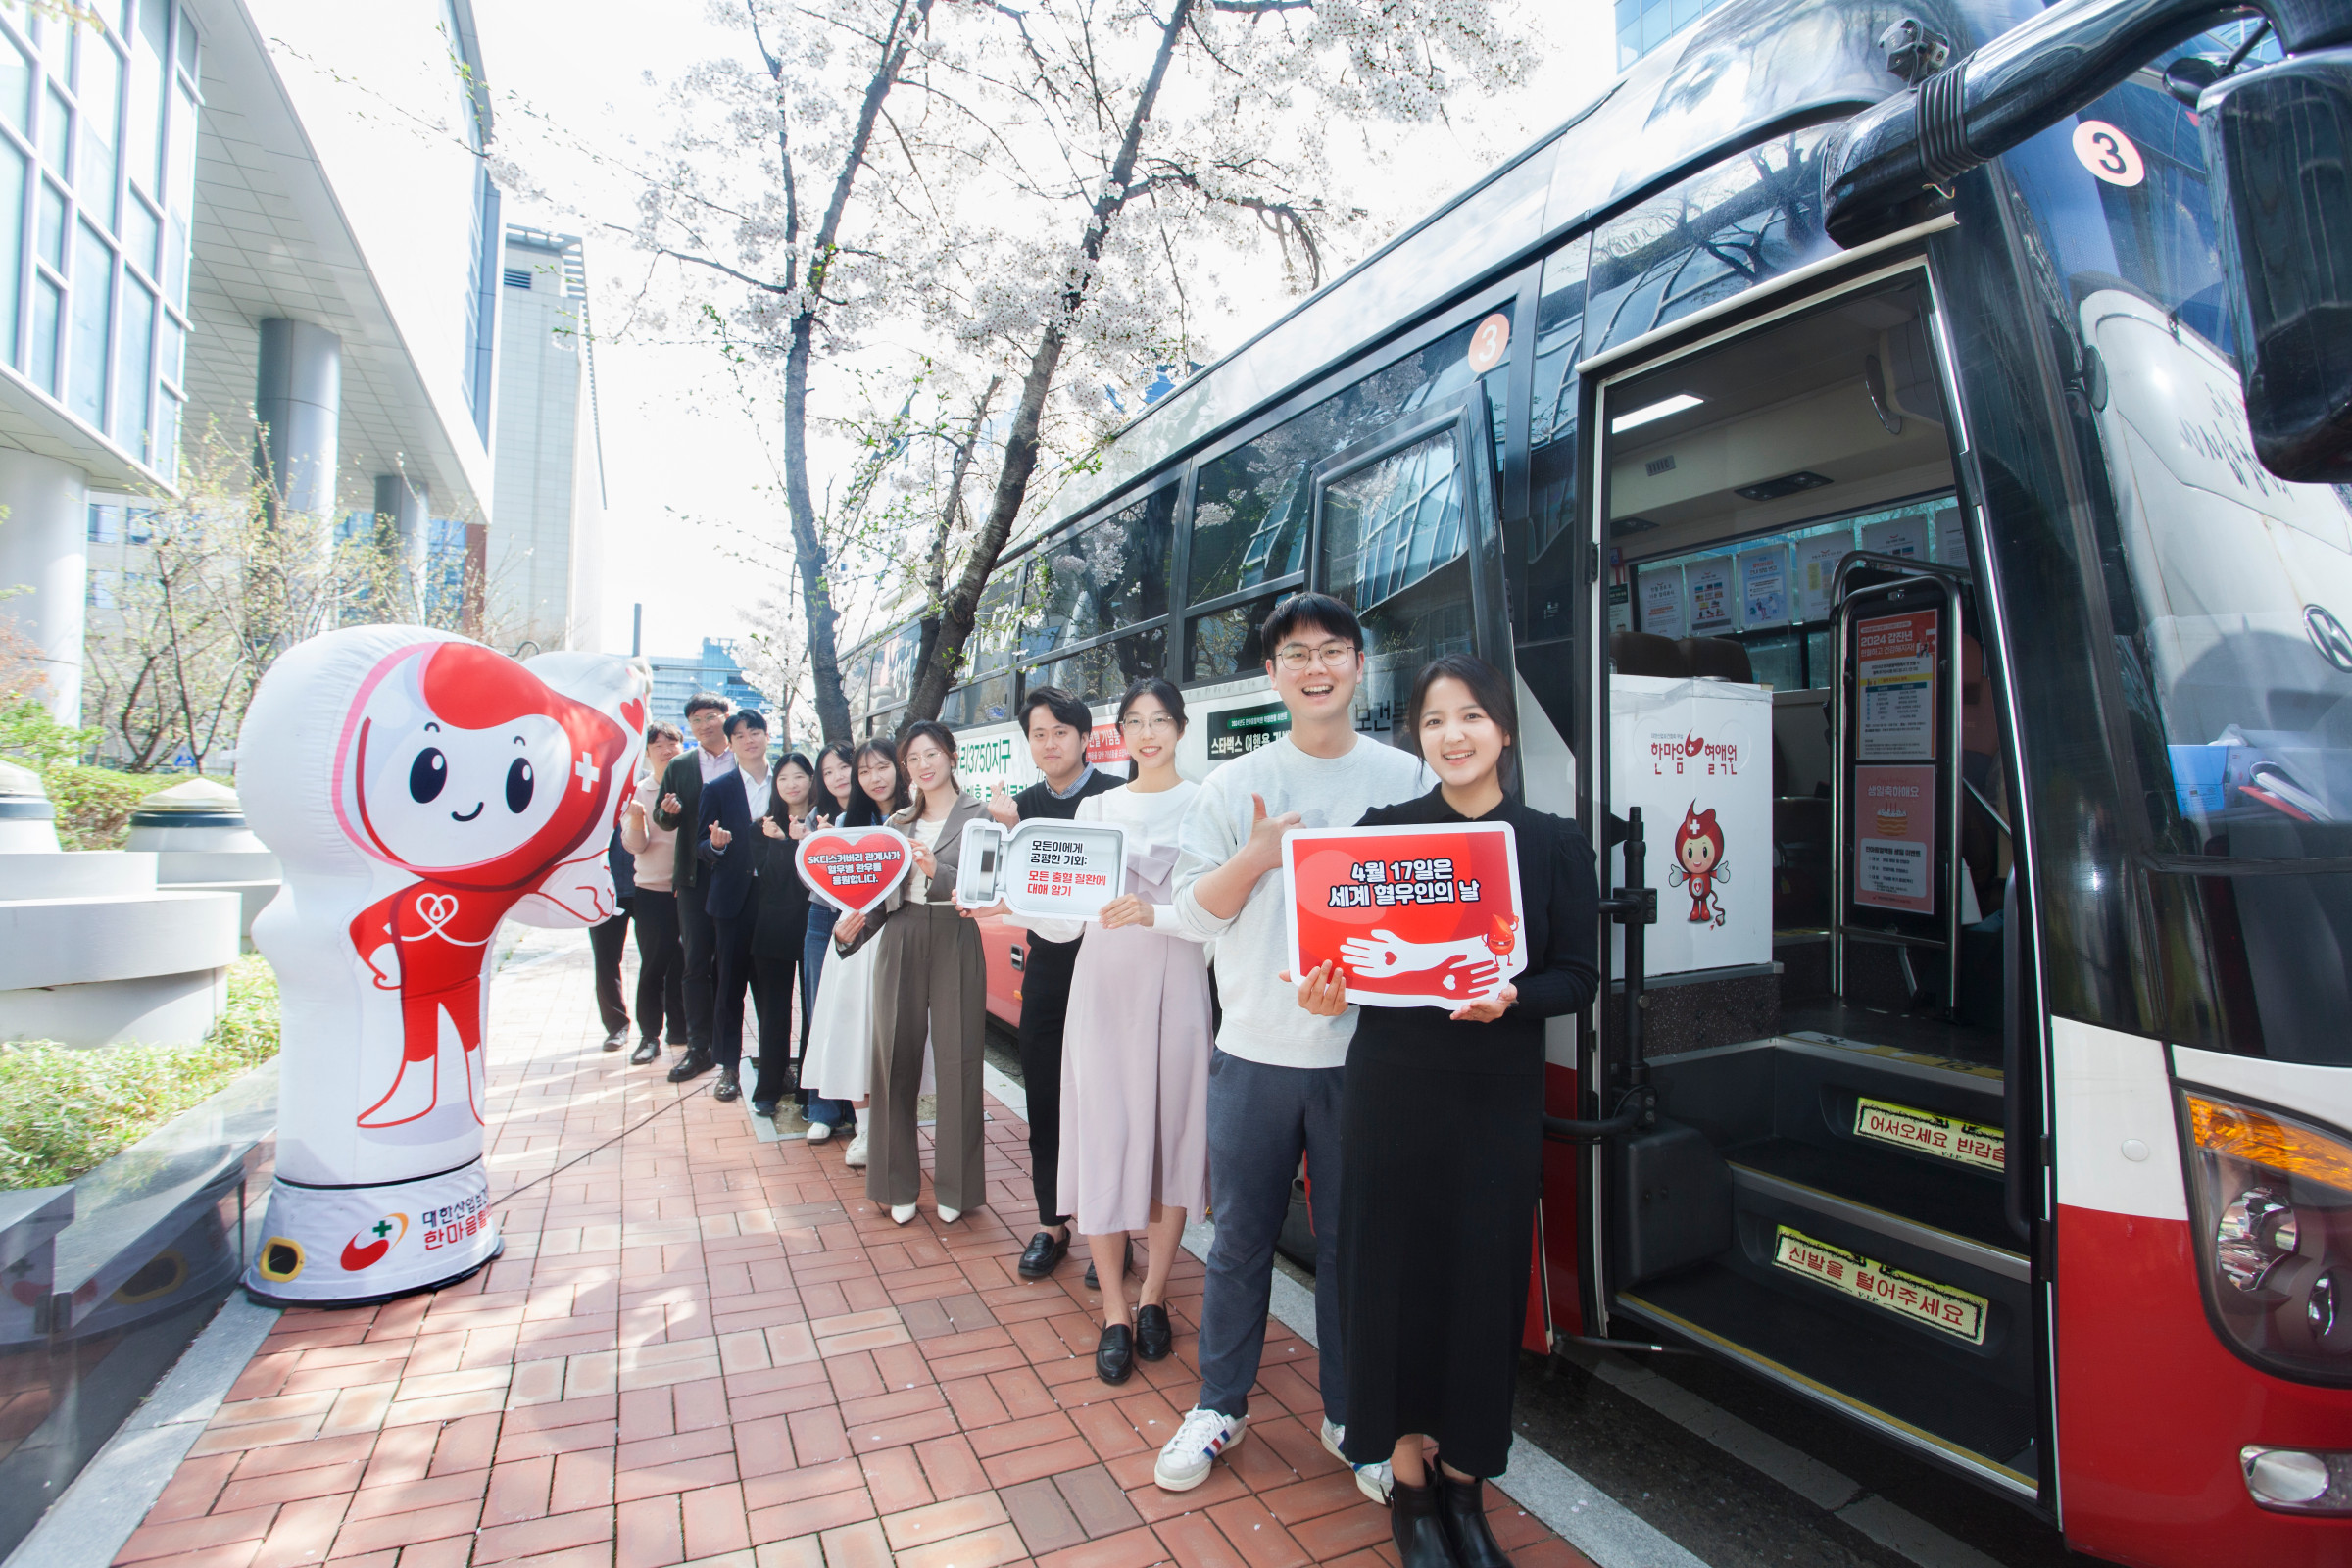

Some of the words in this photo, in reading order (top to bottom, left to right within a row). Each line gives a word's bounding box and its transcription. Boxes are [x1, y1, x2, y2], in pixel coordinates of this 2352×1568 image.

[2092, 132, 2127, 175] 3
[1478, 323, 1498, 363] 3
[1861, 634, 1886, 647] 2024
[1887, 631, 1913, 643] 갑진년
[1101, 729, 1121, 746] 기념품
[1211, 736, 1243, 754] 스타벅스
[1651, 742, 1684, 775] 한마음
[1704, 743, 1738, 775] 혈액원
[1867, 785, 1920, 798] 생일축하해요
[1032, 840, 1083, 853] 모든이에게
[808, 853, 863, 864] SK디스커버리
[864, 851, 901, 861] 관계사가
[1030, 853, 1061, 865] 공평한
[1063, 855, 1088, 866] 기회:
[827, 864, 854, 875] 혈우병
[856, 862, 882, 873] 환우를
[1350, 860, 1387, 884] 4월
[1389, 858, 1454, 882] 17일은
[832, 874, 879, 885] 응원합니다.
[1028, 870, 1050, 882] 모든
[1052, 871, 1073, 884] 출혈
[1074, 873, 1106, 886] 질환에
[1027, 883, 1049, 895] 대해
[1051, 884, 1072, 897] 알기
[1328, 885, 1371, 908] 세계
[1373, 880, 1455, 906] 혈우인의
[1458, 879, 1481, 903] 날
[1869, 1114, 1948, 1149] 어서오세요
[1788, 1247, 1845, 1280] 신발을
[1855, 1271, 1964, 1327] 털어주세요
